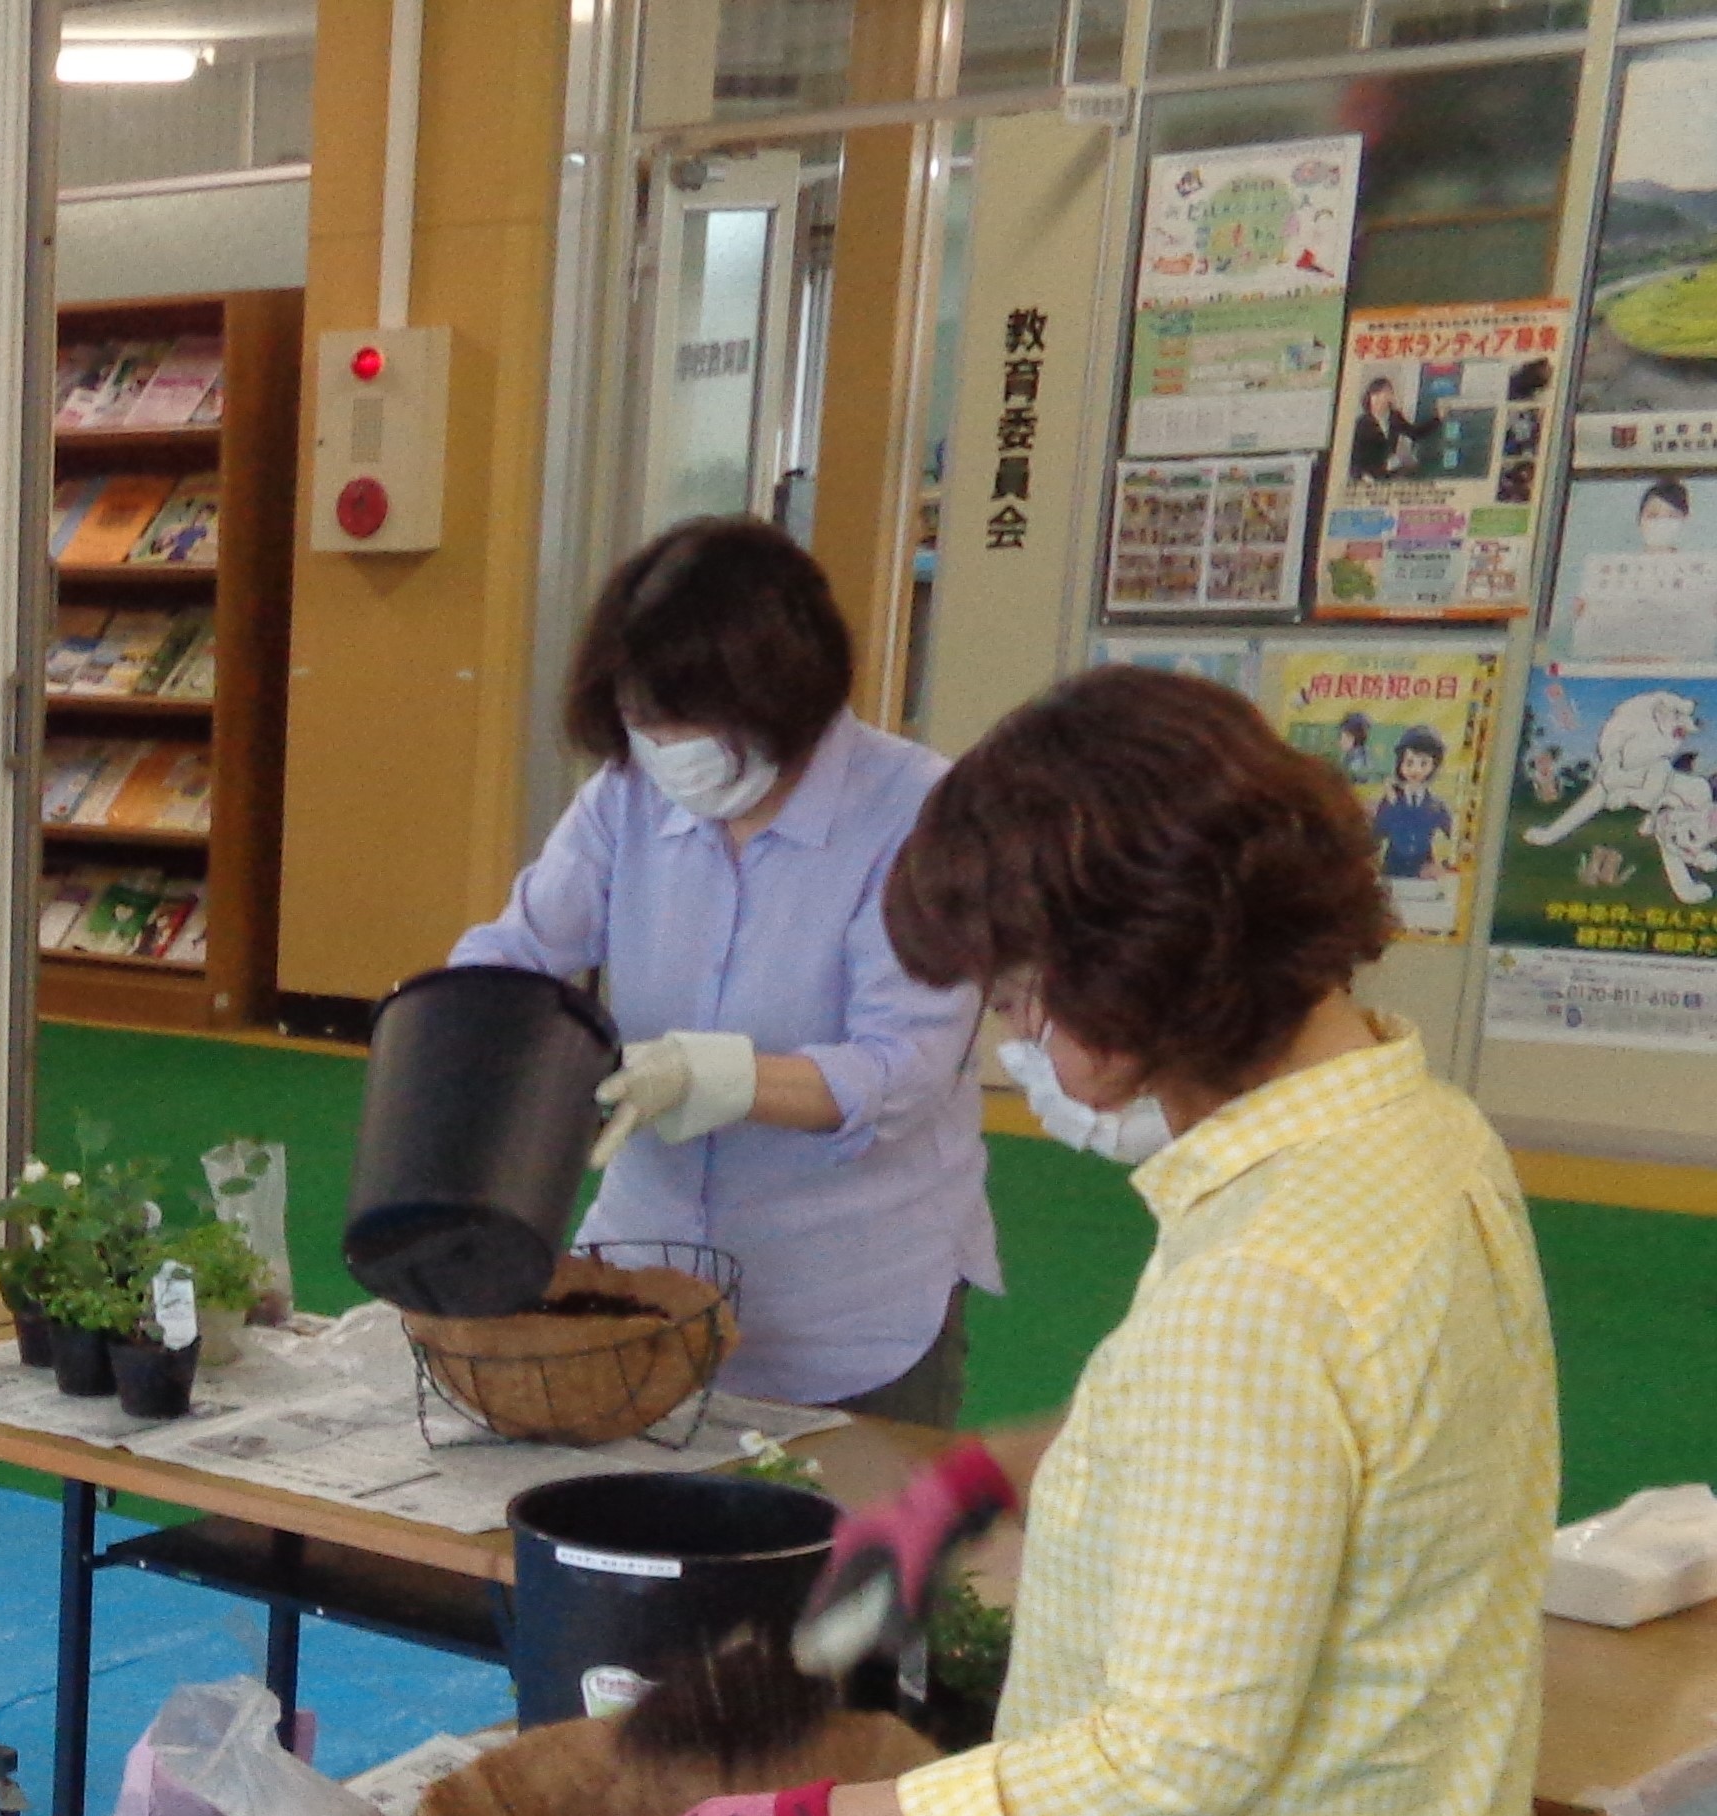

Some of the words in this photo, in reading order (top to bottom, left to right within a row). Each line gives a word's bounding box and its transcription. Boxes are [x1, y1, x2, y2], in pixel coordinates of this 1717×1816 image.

[1355, 327, 1557, 359] 学生ボランティア募集
[986, 308, 1048, 548] 教育委員会
[1307, 673, 1458, 701] 府民防犯の日
